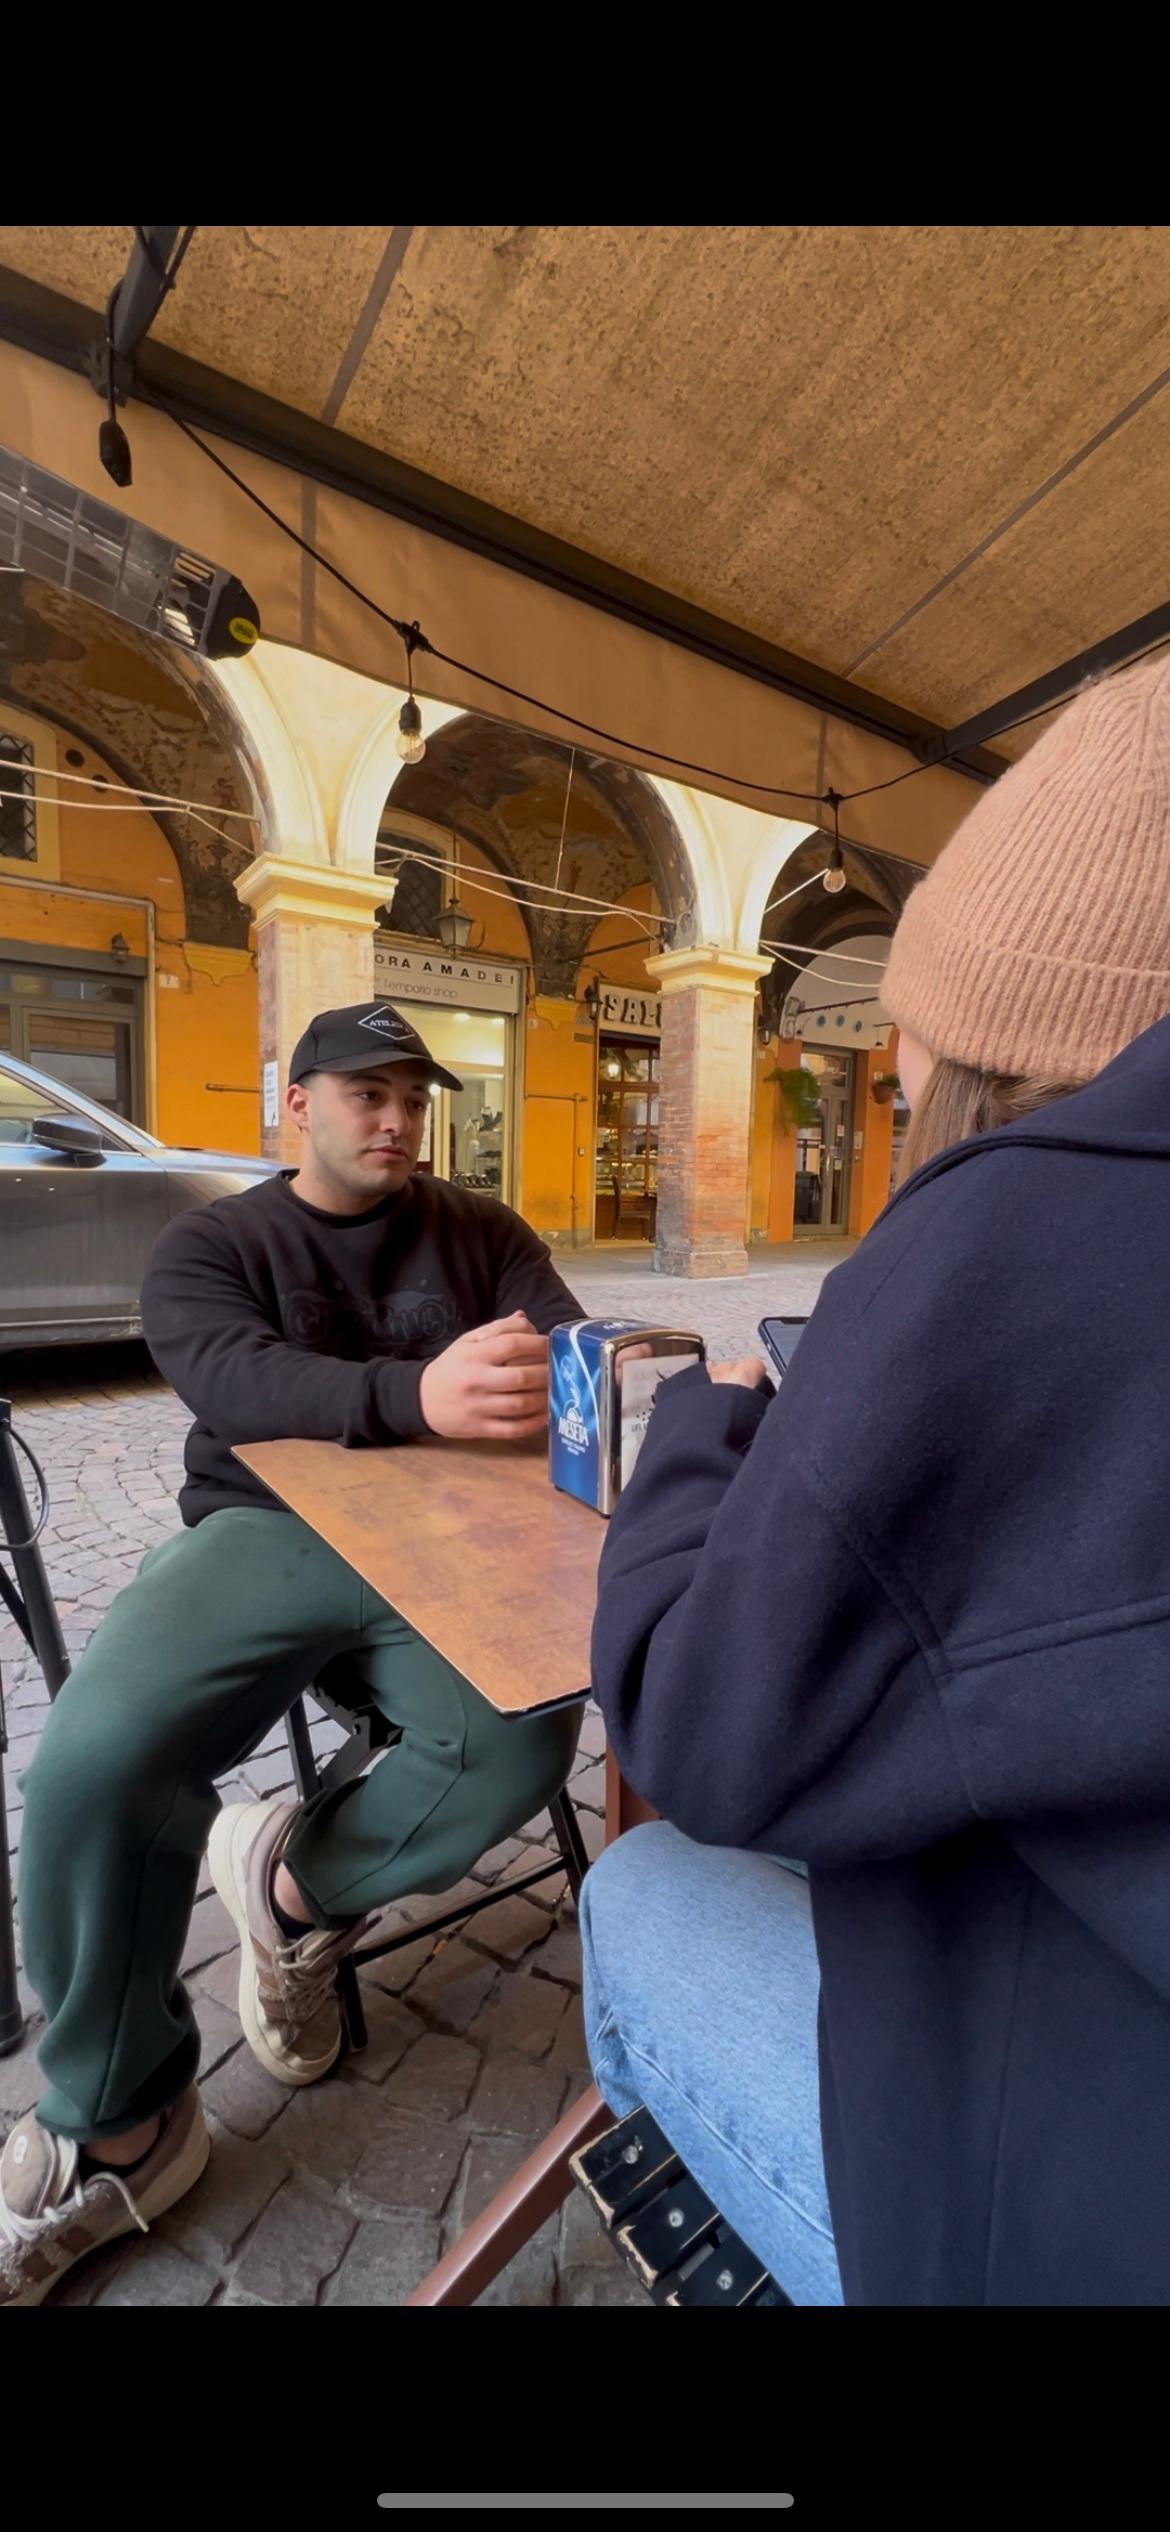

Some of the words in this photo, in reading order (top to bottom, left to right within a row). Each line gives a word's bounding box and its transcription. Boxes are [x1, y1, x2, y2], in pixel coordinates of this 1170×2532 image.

[422, 961, 514, 985] AMADEI
[603, 993, 662, 1029] SAL
[558, 1416, 590, 1448] MESETA
